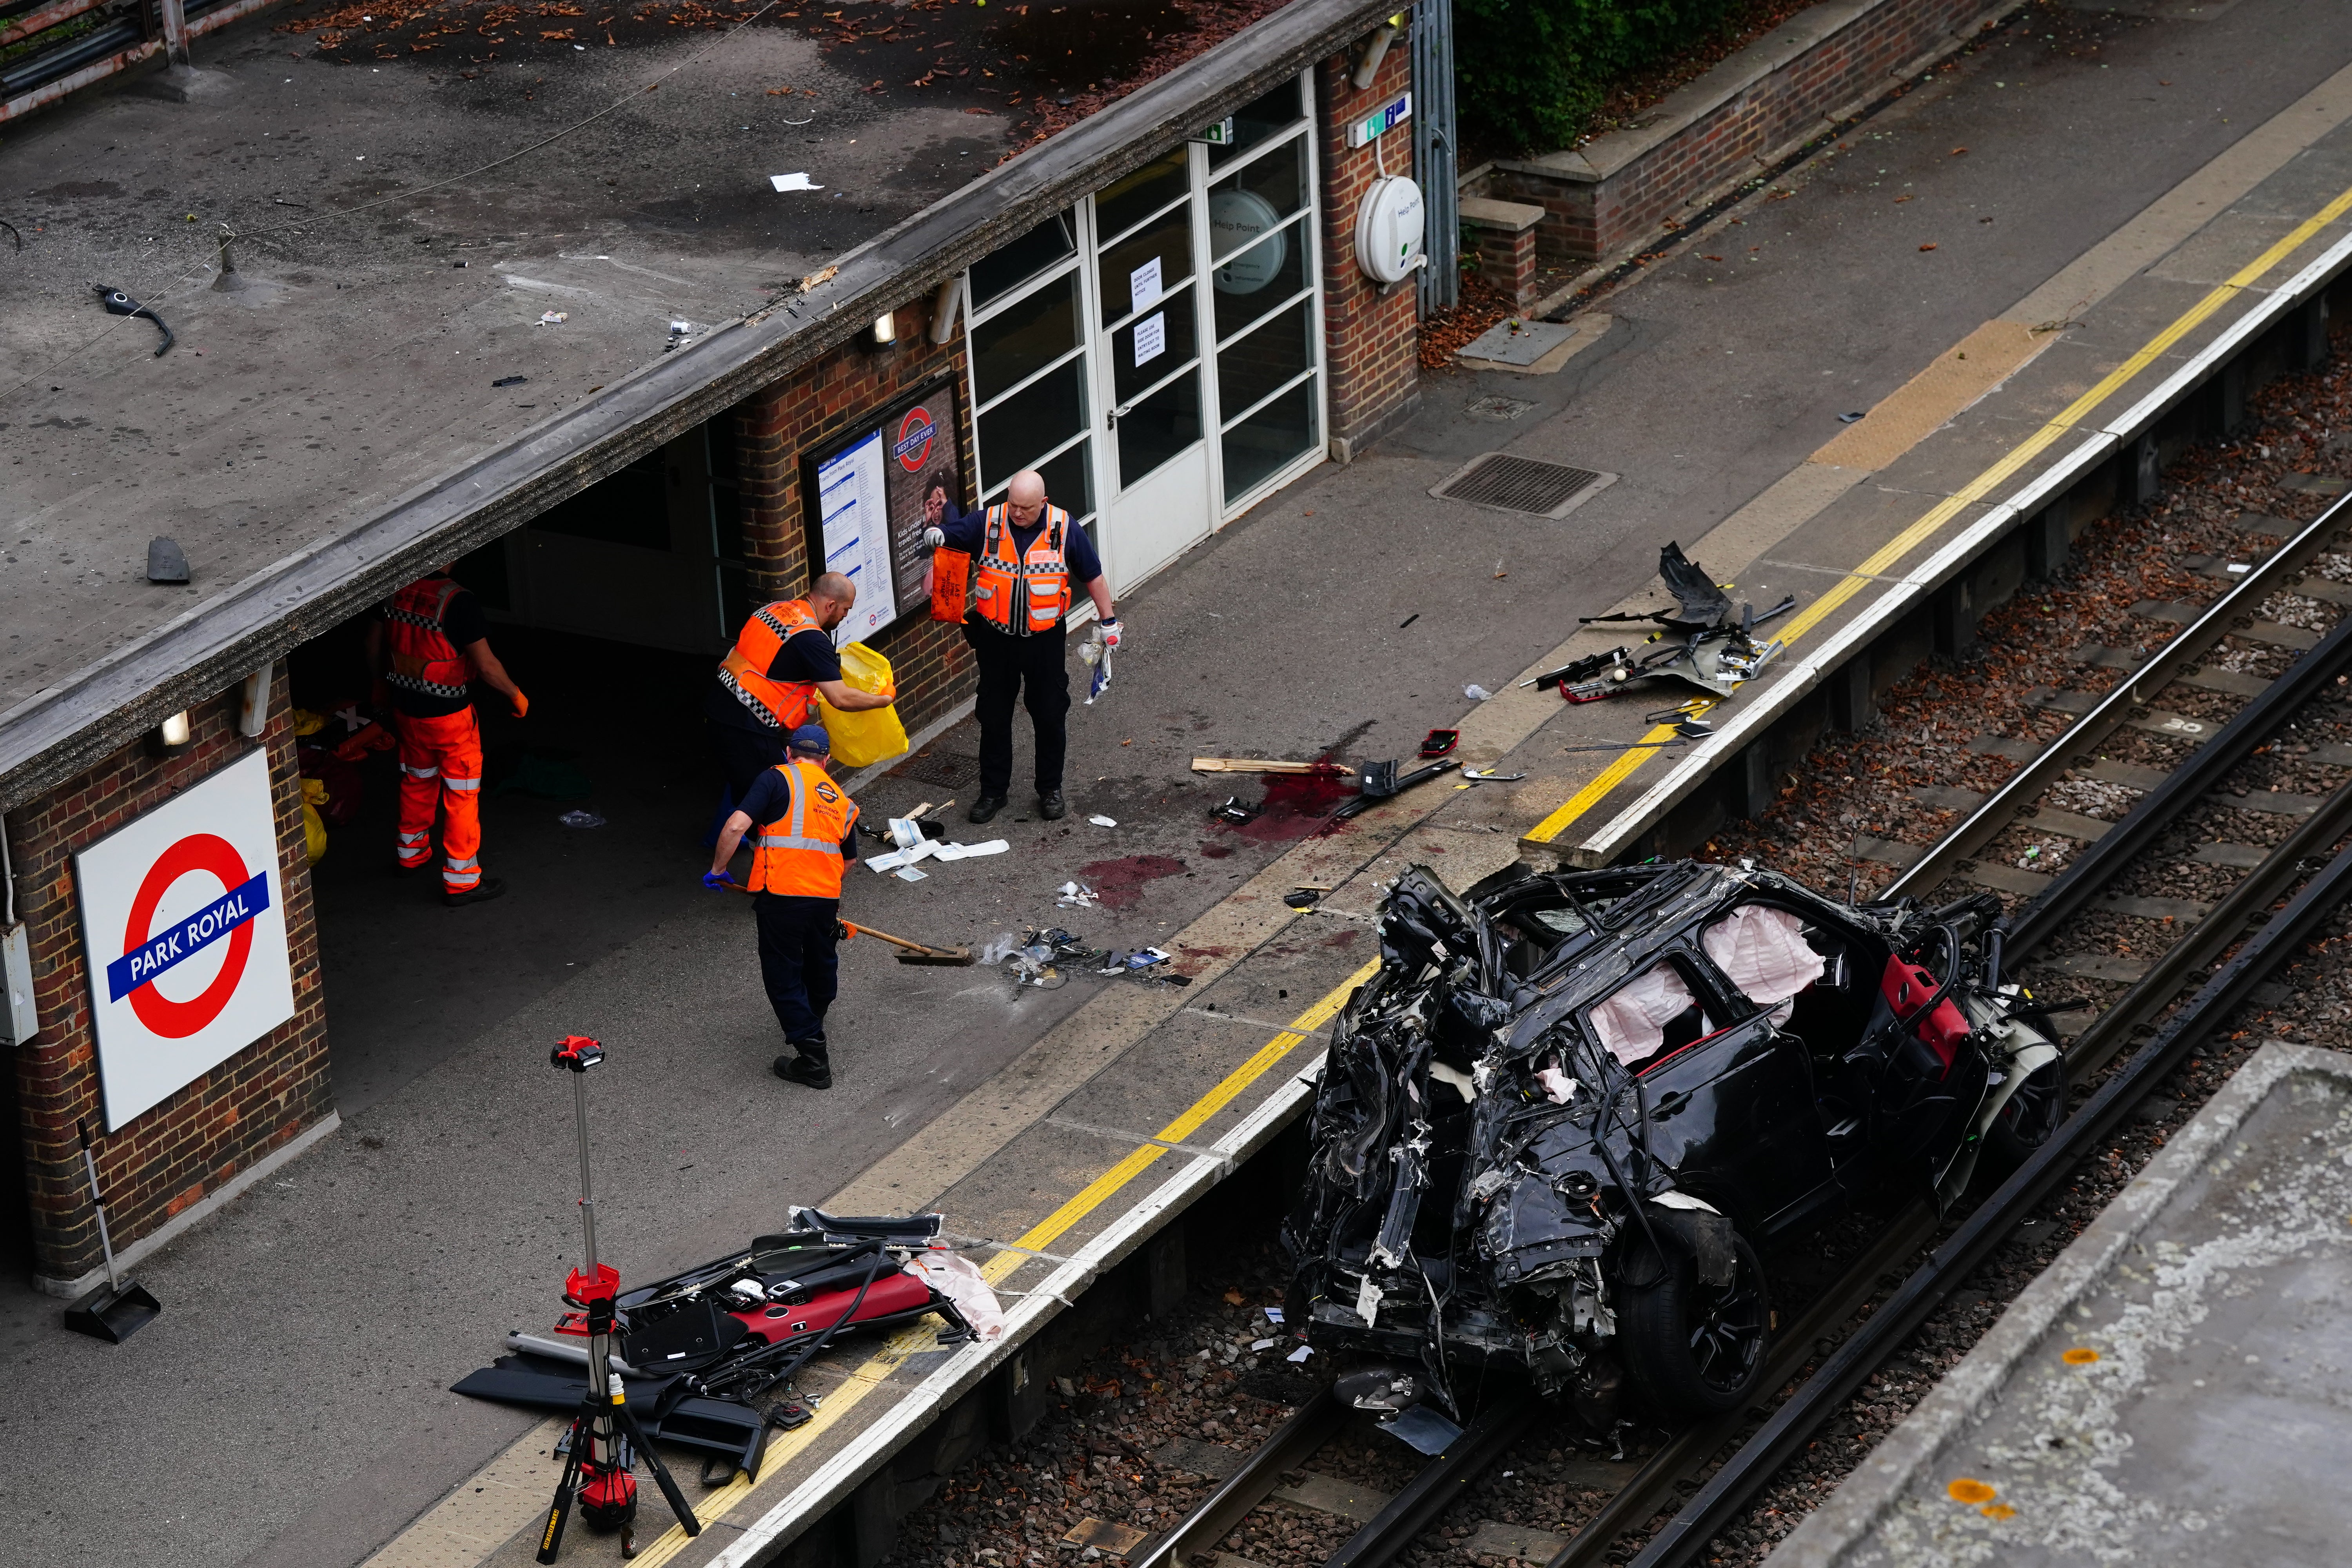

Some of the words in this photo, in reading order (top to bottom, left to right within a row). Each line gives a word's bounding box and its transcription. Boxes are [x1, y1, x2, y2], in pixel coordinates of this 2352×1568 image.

[1398, 206, 1410, 218] Help
[1410, 197, 1419, 210] Point
[1214, 219, 1234, 231] Help
[1236, 223, 1260, 232] Point
[1143, 267, 1154, 277] CLOSED
[1143, 272, 1157, 284] FURTHER
[1135, 287, 1145, 296] NOTICE
[1137, 327, 1148, 336] PLEASE
[1138, 348, 1151, 358] WAITING
[897, 441, 909, 454] BEST
[910, 434, 920, 446] DAY
[920, 427, 933, 439] EVER
[819, 475, 829, 483] Trains
[845, 457, 854, 466] Royal
[898, 528, 908, 539] Kids
[908, 519, 922, 532] under
[898, 534, 912, 548] travel
[912, 528, 922, 538] free
[2161, 718, 2202, 733] 30
[816, 787, 838, 798] UNDERGROUND
[131, 931, 183, 981] PARK
[187, 894, 249, 947] ROYAL
[543, 1524, 554, 1549] 108ERU
